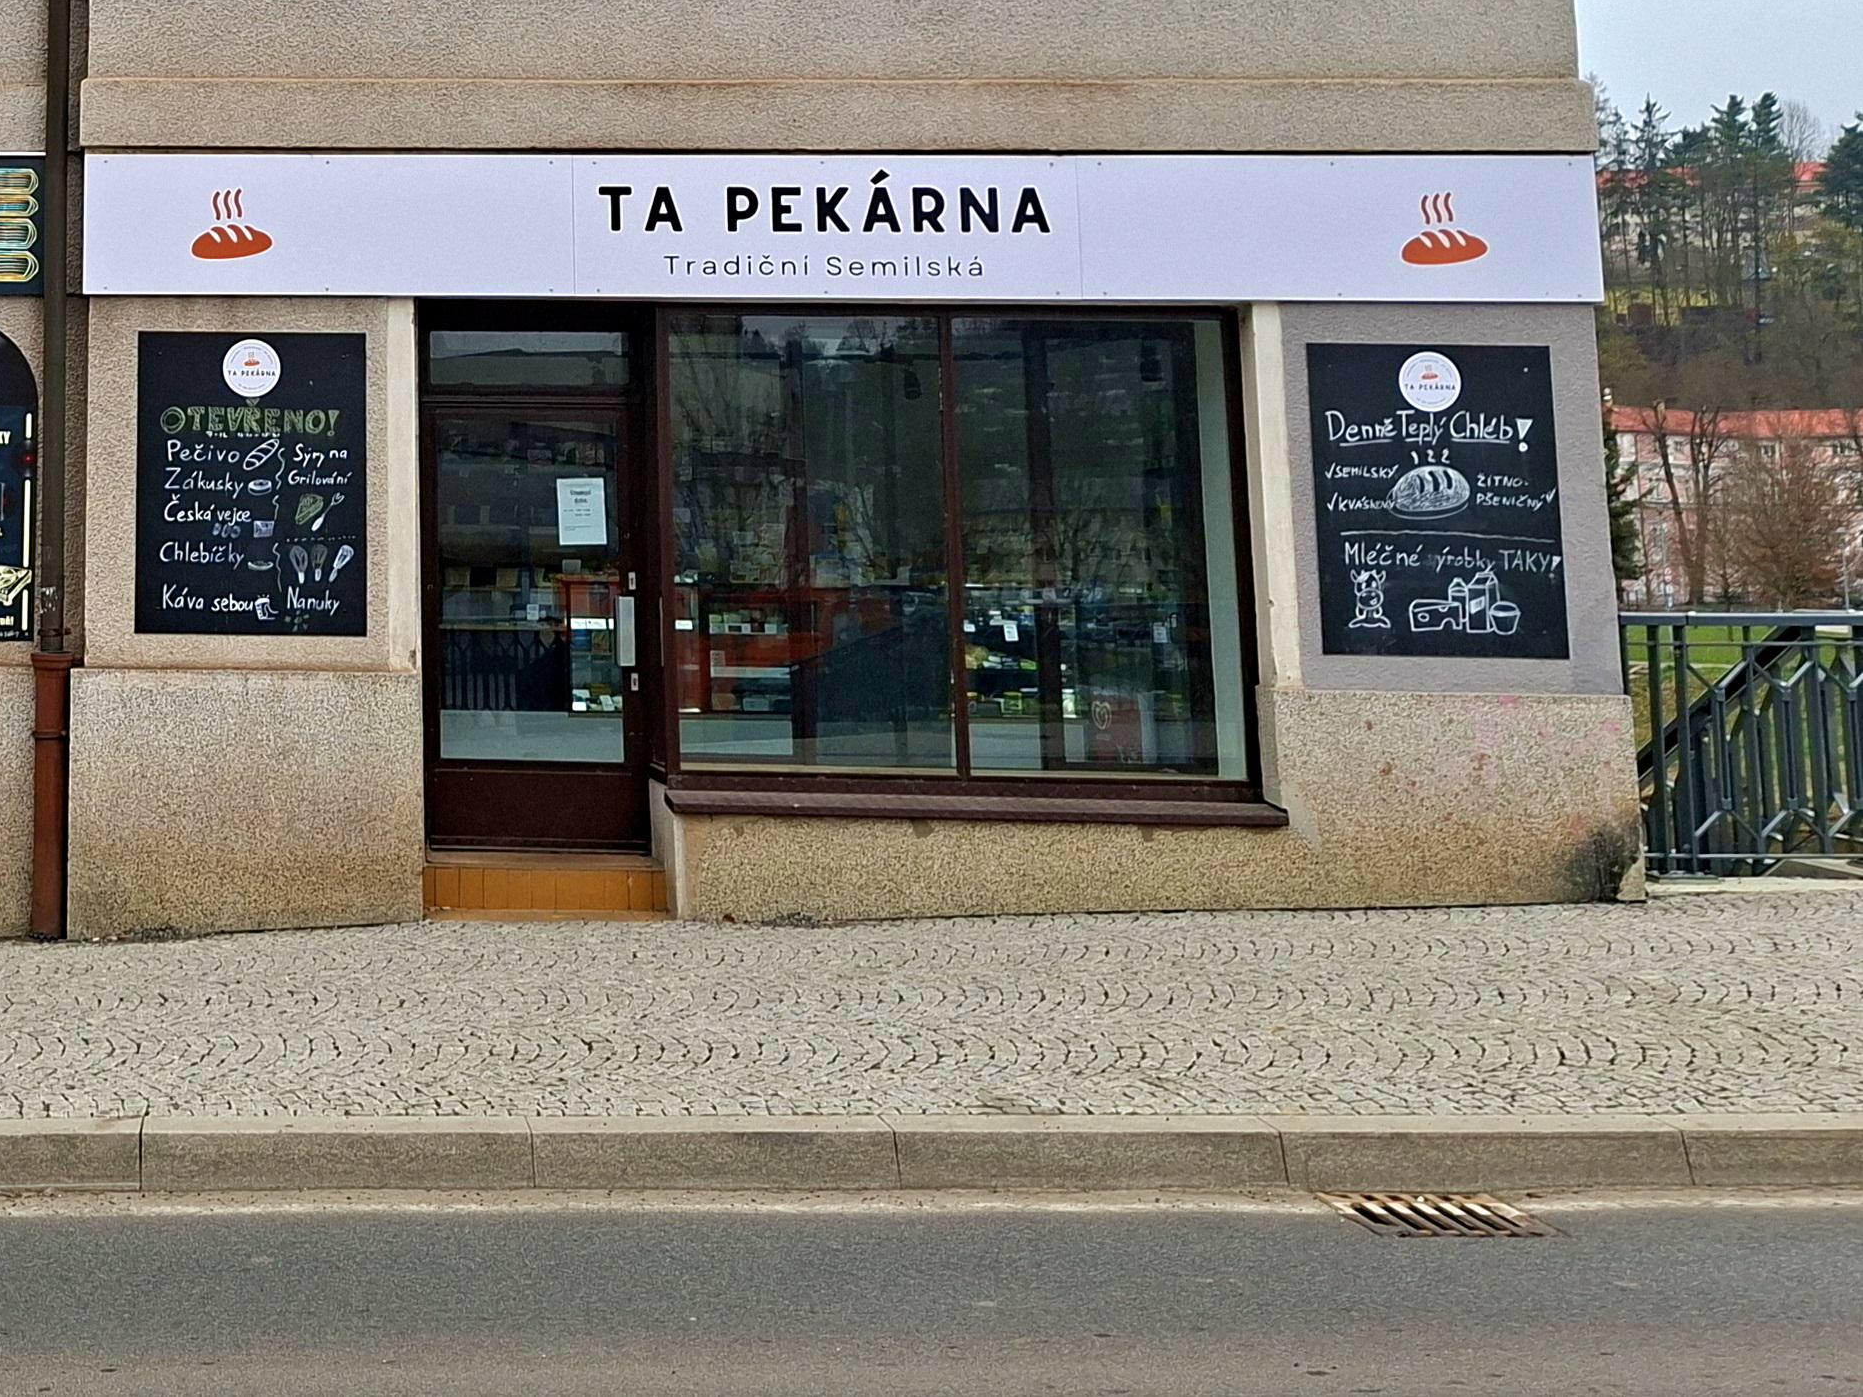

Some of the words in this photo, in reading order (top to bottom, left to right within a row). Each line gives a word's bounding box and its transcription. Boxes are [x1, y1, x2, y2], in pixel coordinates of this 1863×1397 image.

[598, 186, 683, 232] TA
[727, 169, 1051, 233] PEKÁRNA
[663, 253, 809, 277] Tradiční
[825, 254, 984, 277] Semilská
[160, 398, 340, 436] OTEVŘENO!
[1325, 410, 1397, 441] Denně
[1396, 410, 1447, 445] Teplý
[166, 439, 240, 462] Pečivo
[293, 443, 325, 468] Sýry
[329, 449, 348, 460] na
[164, 467, 244, 499] Zákusky
[288, 469, 353, 485] Grilování
[164, 493, 215, 522] Česká
[217, 507, 252, 525] vejce
[159, 542, 245, 570] Chlebíčky
[1344, 541, 1424, 566] Mléčné
[1428, 546, 1496, 573] ýrobky
[162, 583, 204, 610] Káva
[211, 593, 253, 612] sebou
[287, 586, 340, 616] Nanuky
